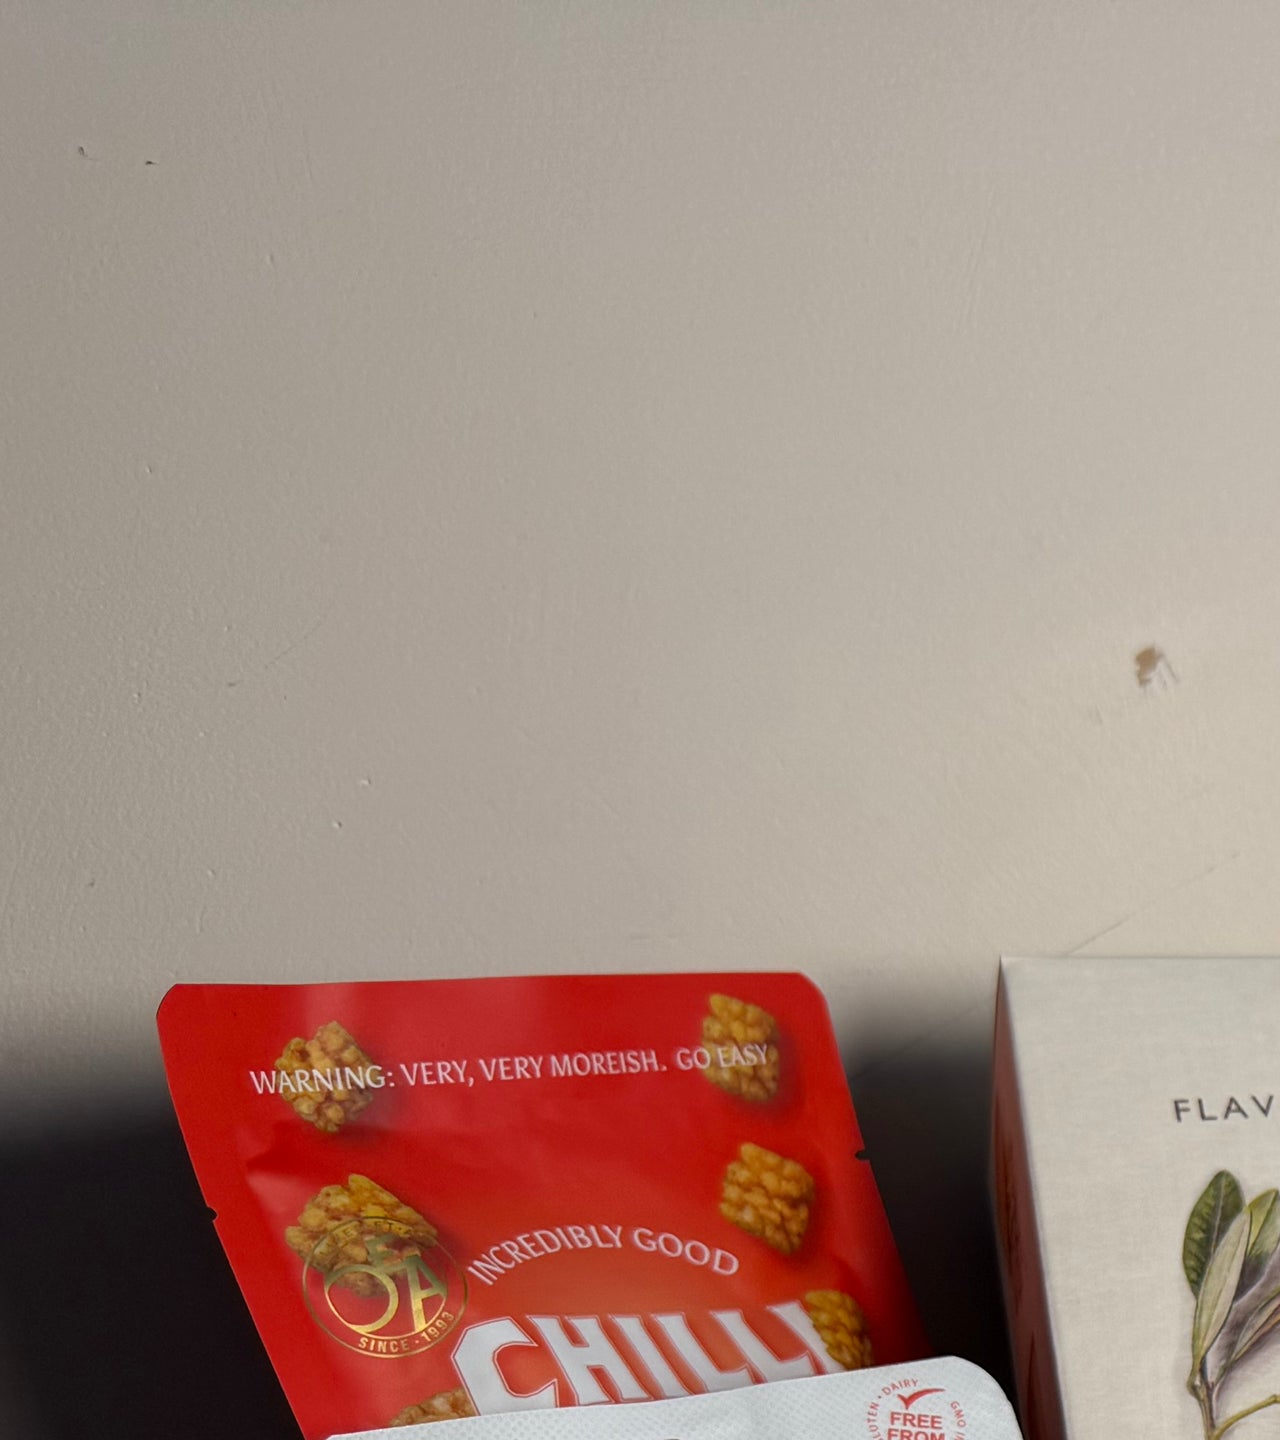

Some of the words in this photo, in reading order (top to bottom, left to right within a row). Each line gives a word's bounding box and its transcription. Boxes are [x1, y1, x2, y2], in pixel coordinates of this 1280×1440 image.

[249, 1064, 395, 1095] WARNING:
[400, 1060, 474, 1088] VERY,
[479, 1055, 543, 1081] VERY
[550, 1049, 667, 1077] MOREISH.
[675, 1047, 711, 1070] GO
[717, 1043, 768, 1068] EASY
[467, 1224, 623, 1286] INCREDIBLY
[631, 1227, 740, 1276] GOOD
[358, 1336, 410, 1354] SINCE
[421, 1311, 455, 1342] 1993
[881, 1377, 919, 1396] DAIRY
[890, 1411, 943, 1430] FREE
[950, 1400, 967, 1428] GMO
